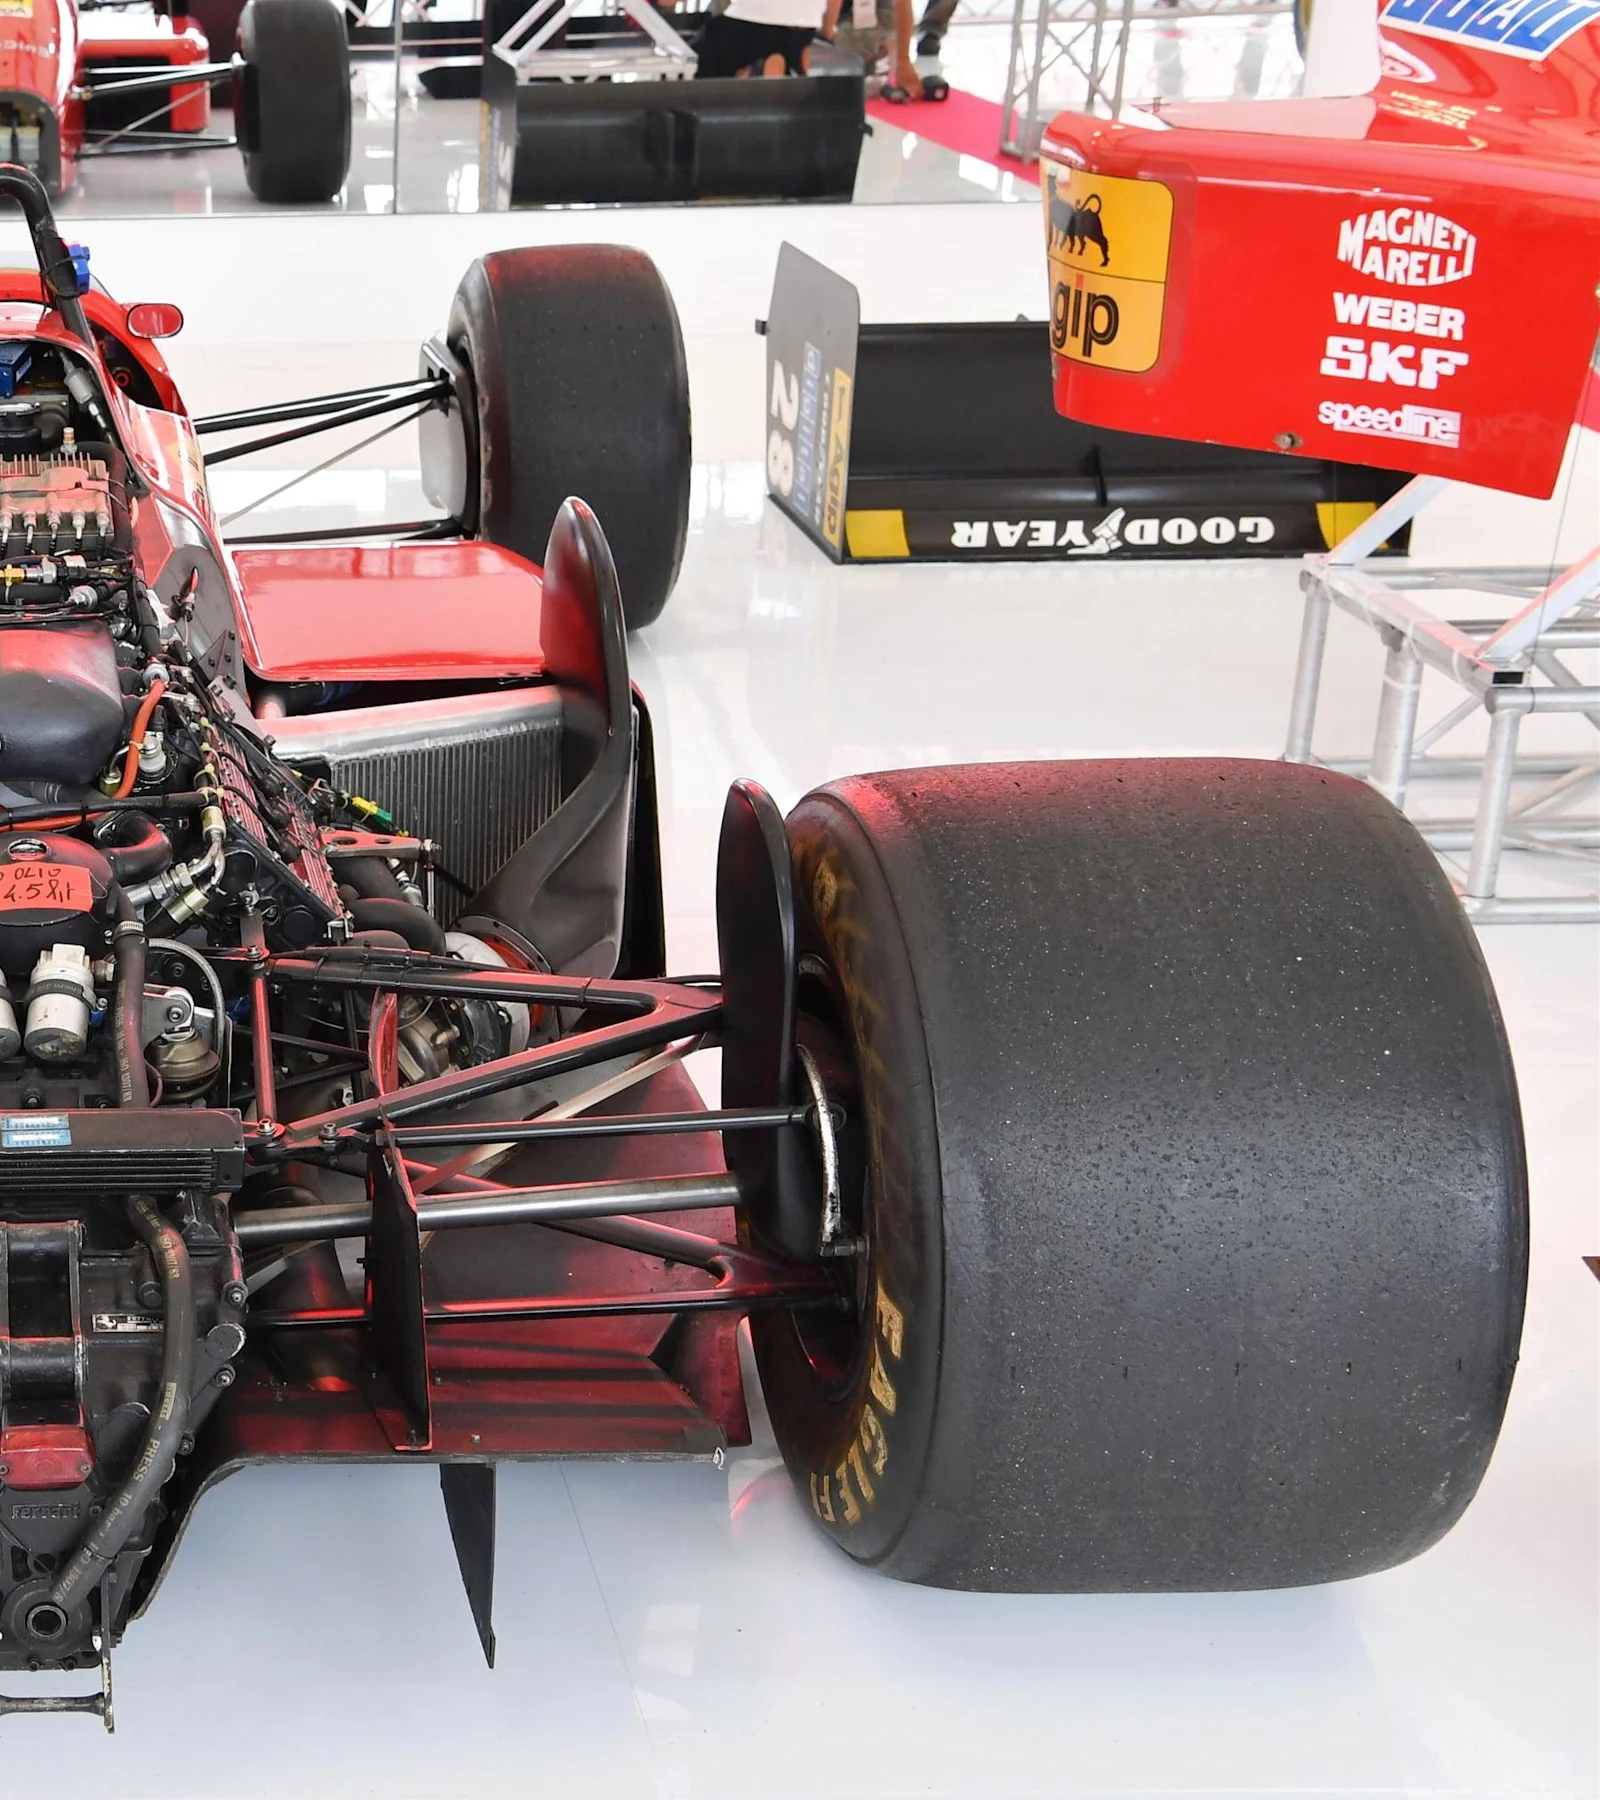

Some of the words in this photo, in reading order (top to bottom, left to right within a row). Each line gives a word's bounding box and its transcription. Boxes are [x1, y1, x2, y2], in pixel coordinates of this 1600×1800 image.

[1337, 207, 1477, 262] MAGNETI
[1337, 236, 1475, 286] MARELLI
[1050, 273, 1119, 358] gip
[1333, 291, 1465, 341] WEBER
[1319, 335, 1469, 390] SKF
[768, 360, 799, 497] 28
[1317, 400, 1461, 446] speedline
[4, 883, 43, 903] 4.5
[14, 867, 61, 880] OLIO
[835, 1279, 903, 1524] EAGLE
[134, 1438, 160, 1482] PRESS
[11, 1501, 79, 1519] Ferrari
[104, 1505, 123, 1530] bar
[119, 1491, 132, 1508] 10
